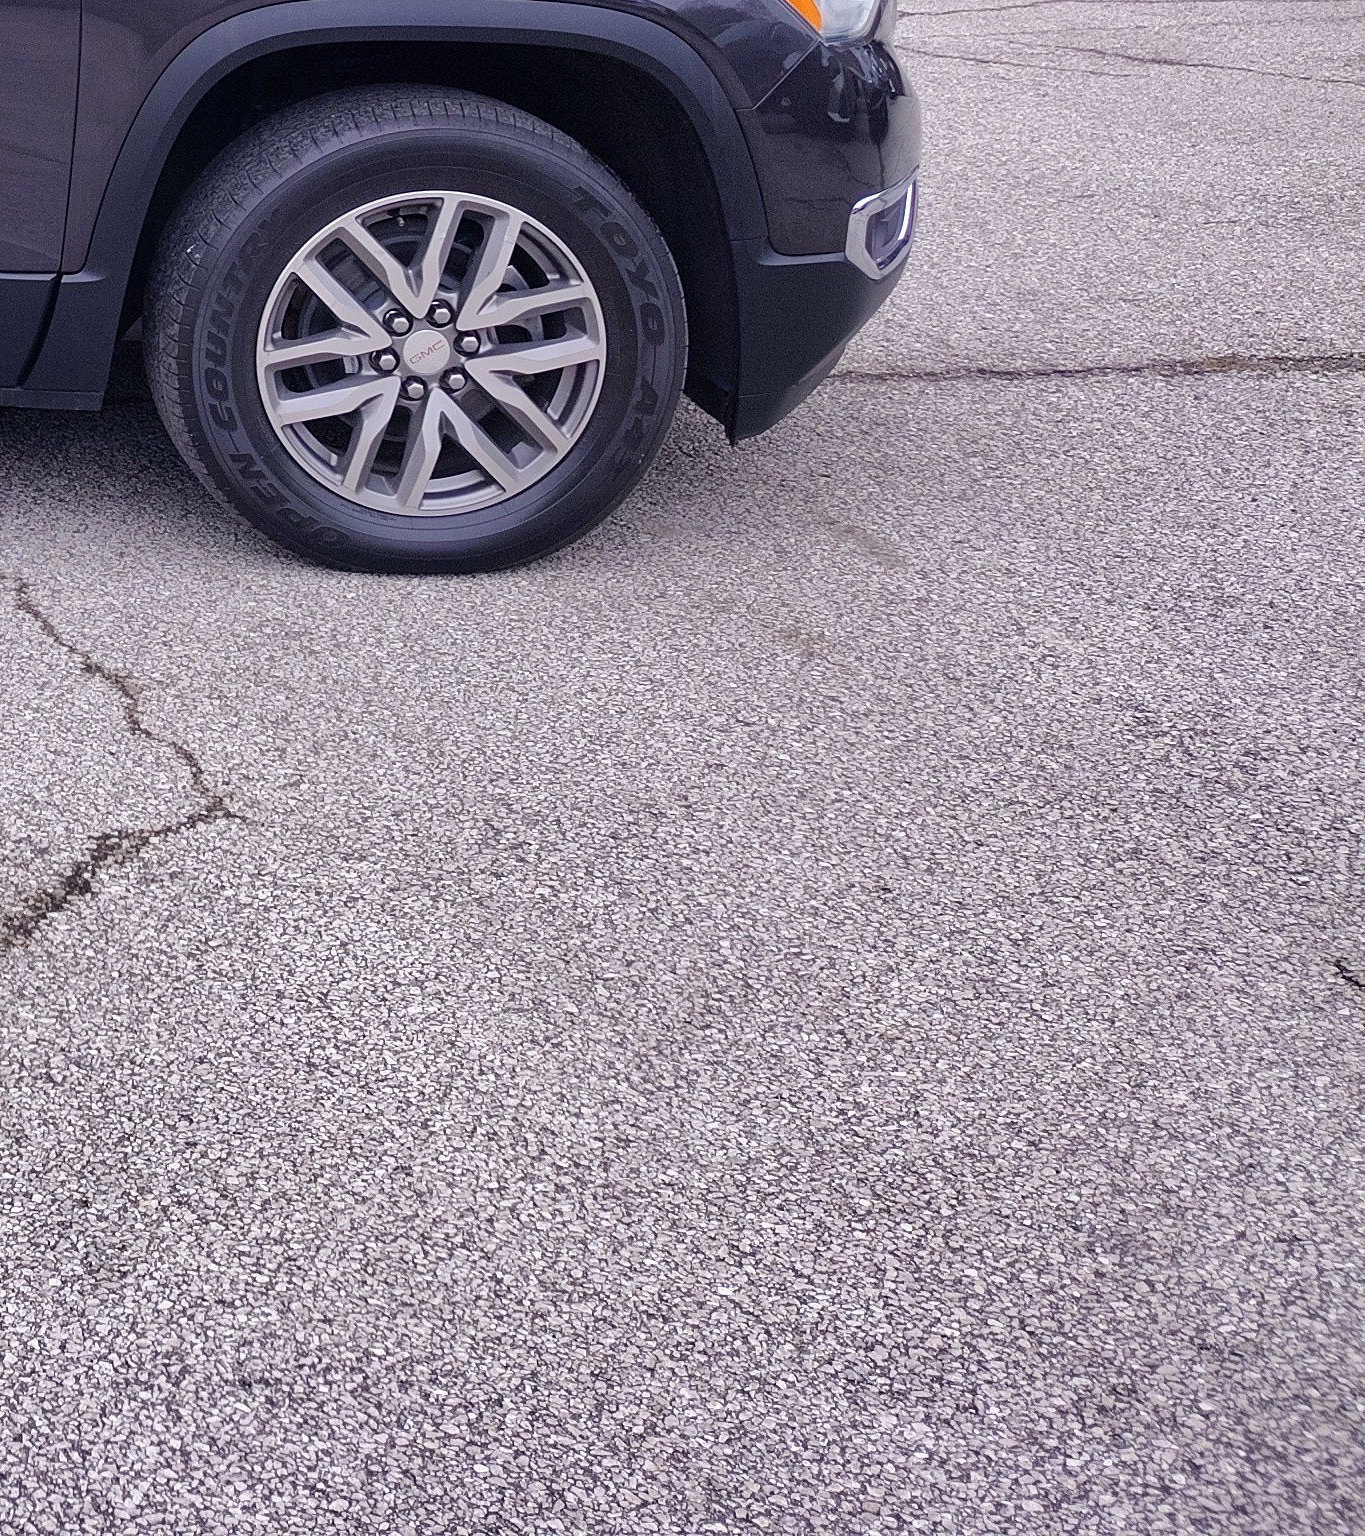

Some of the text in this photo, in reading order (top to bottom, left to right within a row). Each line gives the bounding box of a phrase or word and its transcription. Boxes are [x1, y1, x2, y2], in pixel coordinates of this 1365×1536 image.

[566, 185, 666, 347] TOYO
[204, 216, 352, 547] OPEN COUNTRY
[409, 339, 446, 365] GMC
